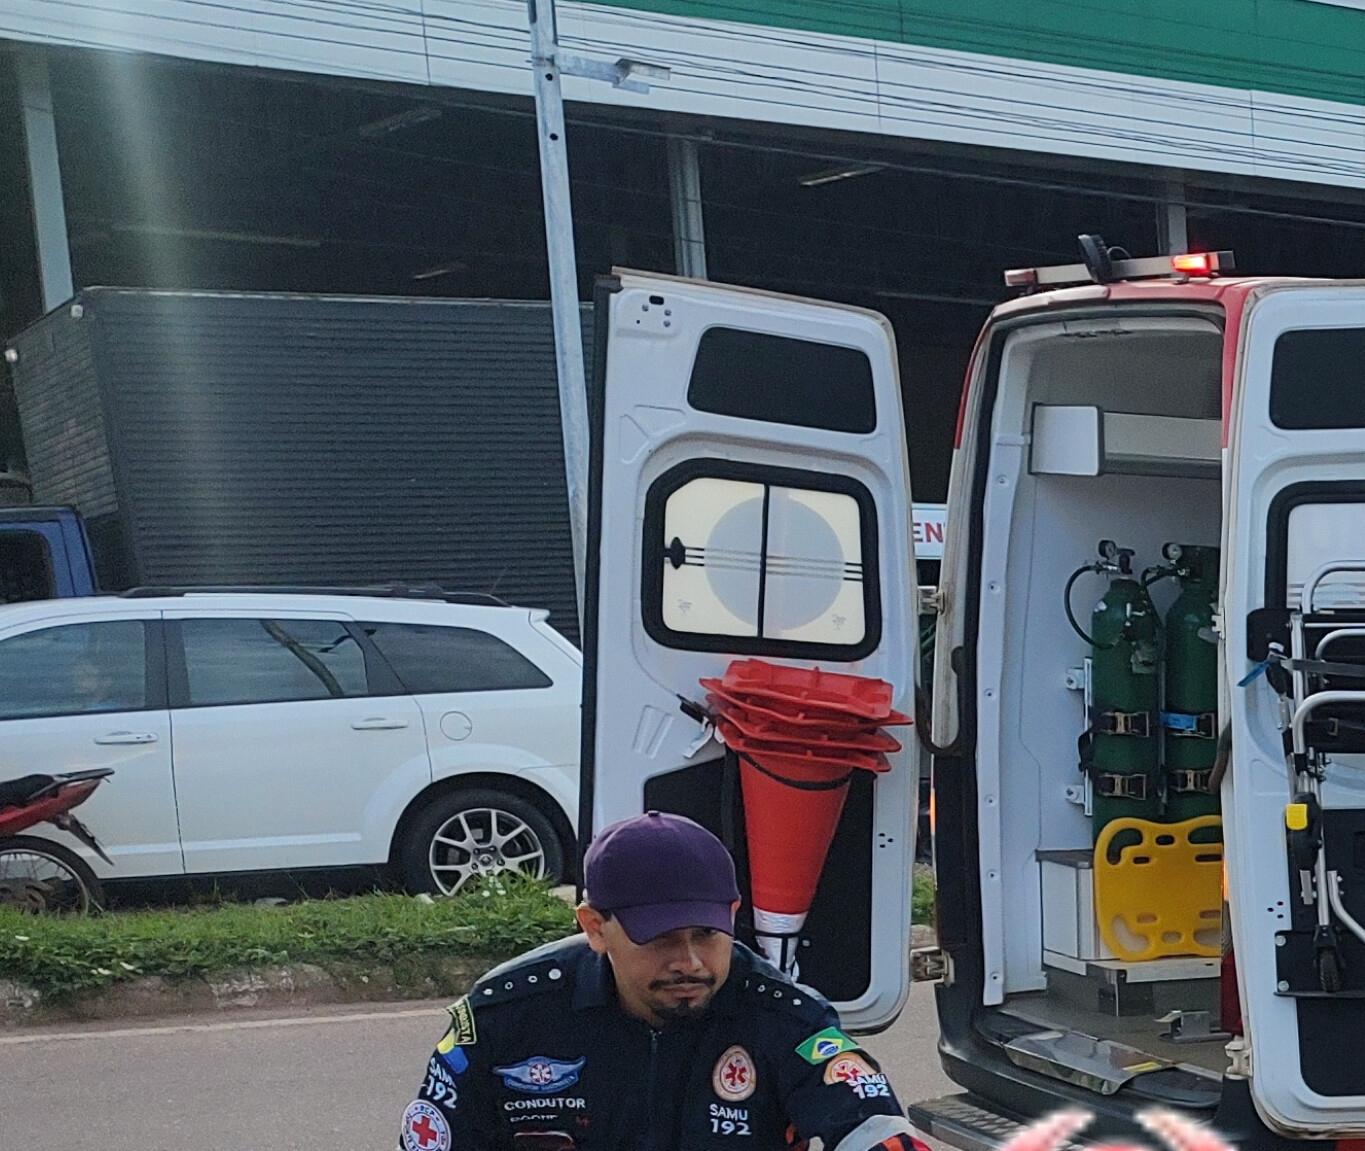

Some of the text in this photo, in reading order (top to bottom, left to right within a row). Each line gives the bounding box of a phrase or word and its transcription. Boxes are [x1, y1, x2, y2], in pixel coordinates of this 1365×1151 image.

[847, 1072, 887, 1087] SAMU
[427, 1074, 458, 1109] 192
[853, 1083, 891, 1099] 192
[504, 1097, 586, 1111] CONDUTOR
[709, 1102, 749, 1121] SAMU
[709, 1117, 752, 1136] 192
